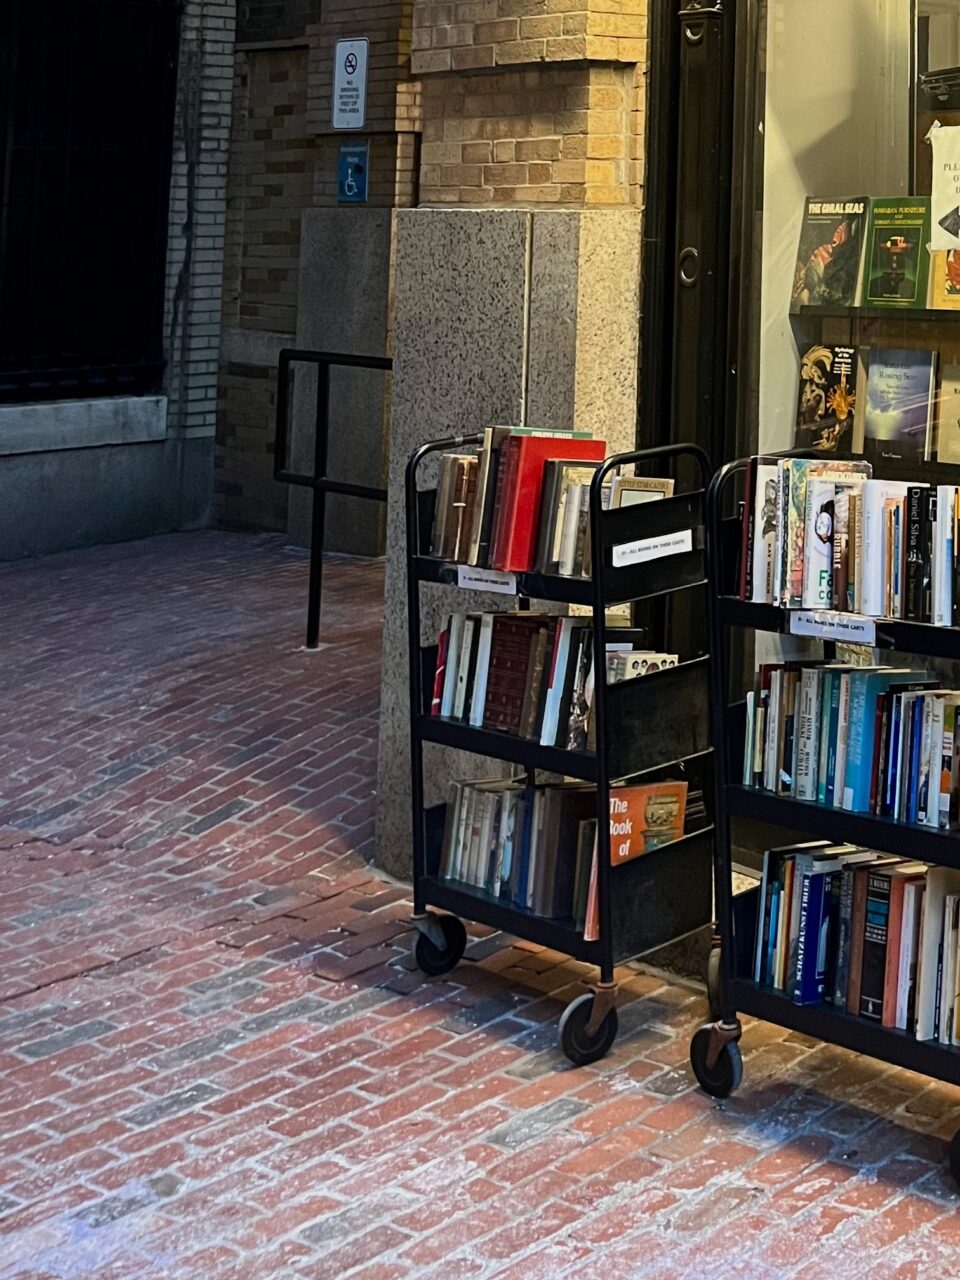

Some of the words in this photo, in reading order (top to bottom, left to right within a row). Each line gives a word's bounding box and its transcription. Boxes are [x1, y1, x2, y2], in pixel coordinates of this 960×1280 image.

[845, 203, 865, 214] SEAS
[911, 489, 921, 520] Daniel
[909, 524, 919, 546] Silva
[609, 797, 628, 815] The
[619, 839, 631, 857] of
